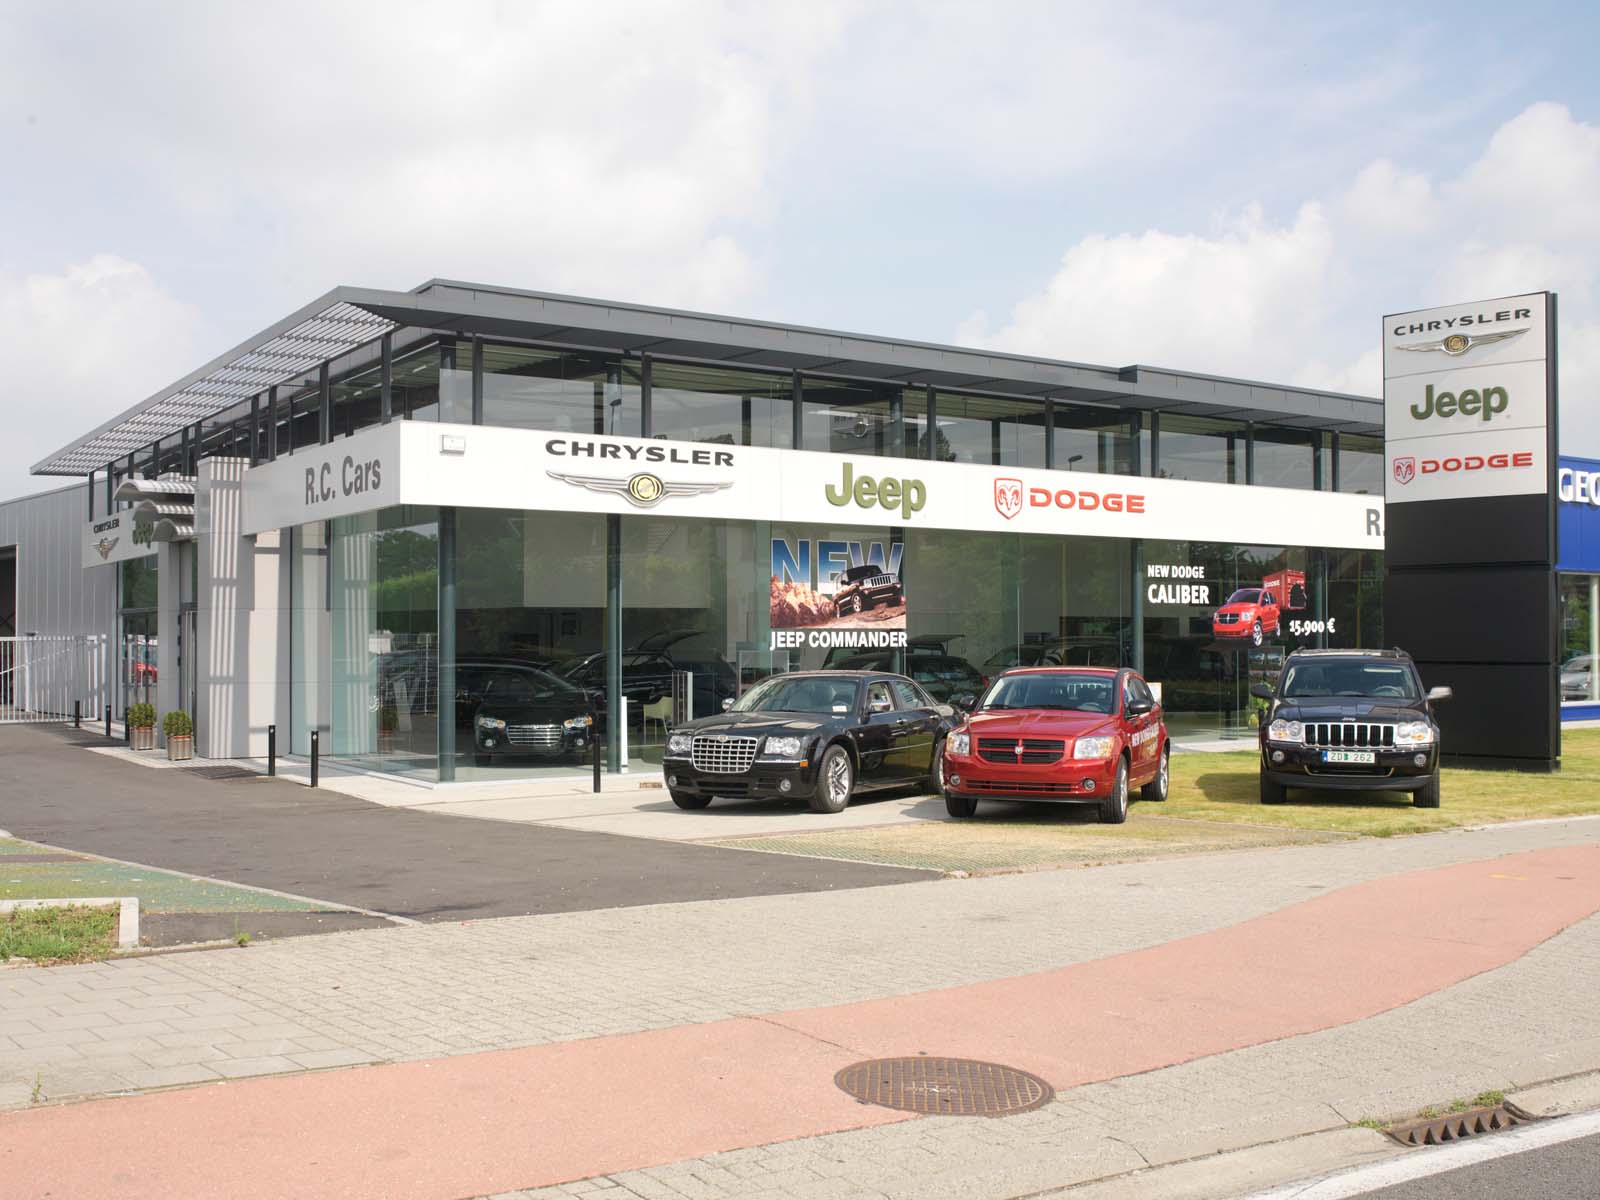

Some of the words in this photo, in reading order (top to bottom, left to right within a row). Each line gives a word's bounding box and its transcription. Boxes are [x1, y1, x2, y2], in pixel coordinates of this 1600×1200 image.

[1394, 308, 1532, 336] CHRYSLER
[1410, 384, 1509, 421] Jeep
[545, 439, 734, 467] CHRYSLER
[1421, 452, 1533, 474] DODGE
[305, 462, 336, 505] R.C.
[342, 455, 381, 496] Cars
[825, 462, 927, 520] Jeep
[1029, 487, 1145, 513] DODGE
[93, 518, 120, 534] CHRYSLER
[771, 538, 904, 595] NEW
[1147, 565, 1169, 578] NEW
[1171, 566, 1204, 579] DODGE
[1148, 584, 1210, 604] CALIBER
[1289, 619, 1325, 637] 15.900
[1326, 618, 1336, 633] €
[769, 631, 805, 651] JEEP
[808, 631, 908, 648] COMMANDER
